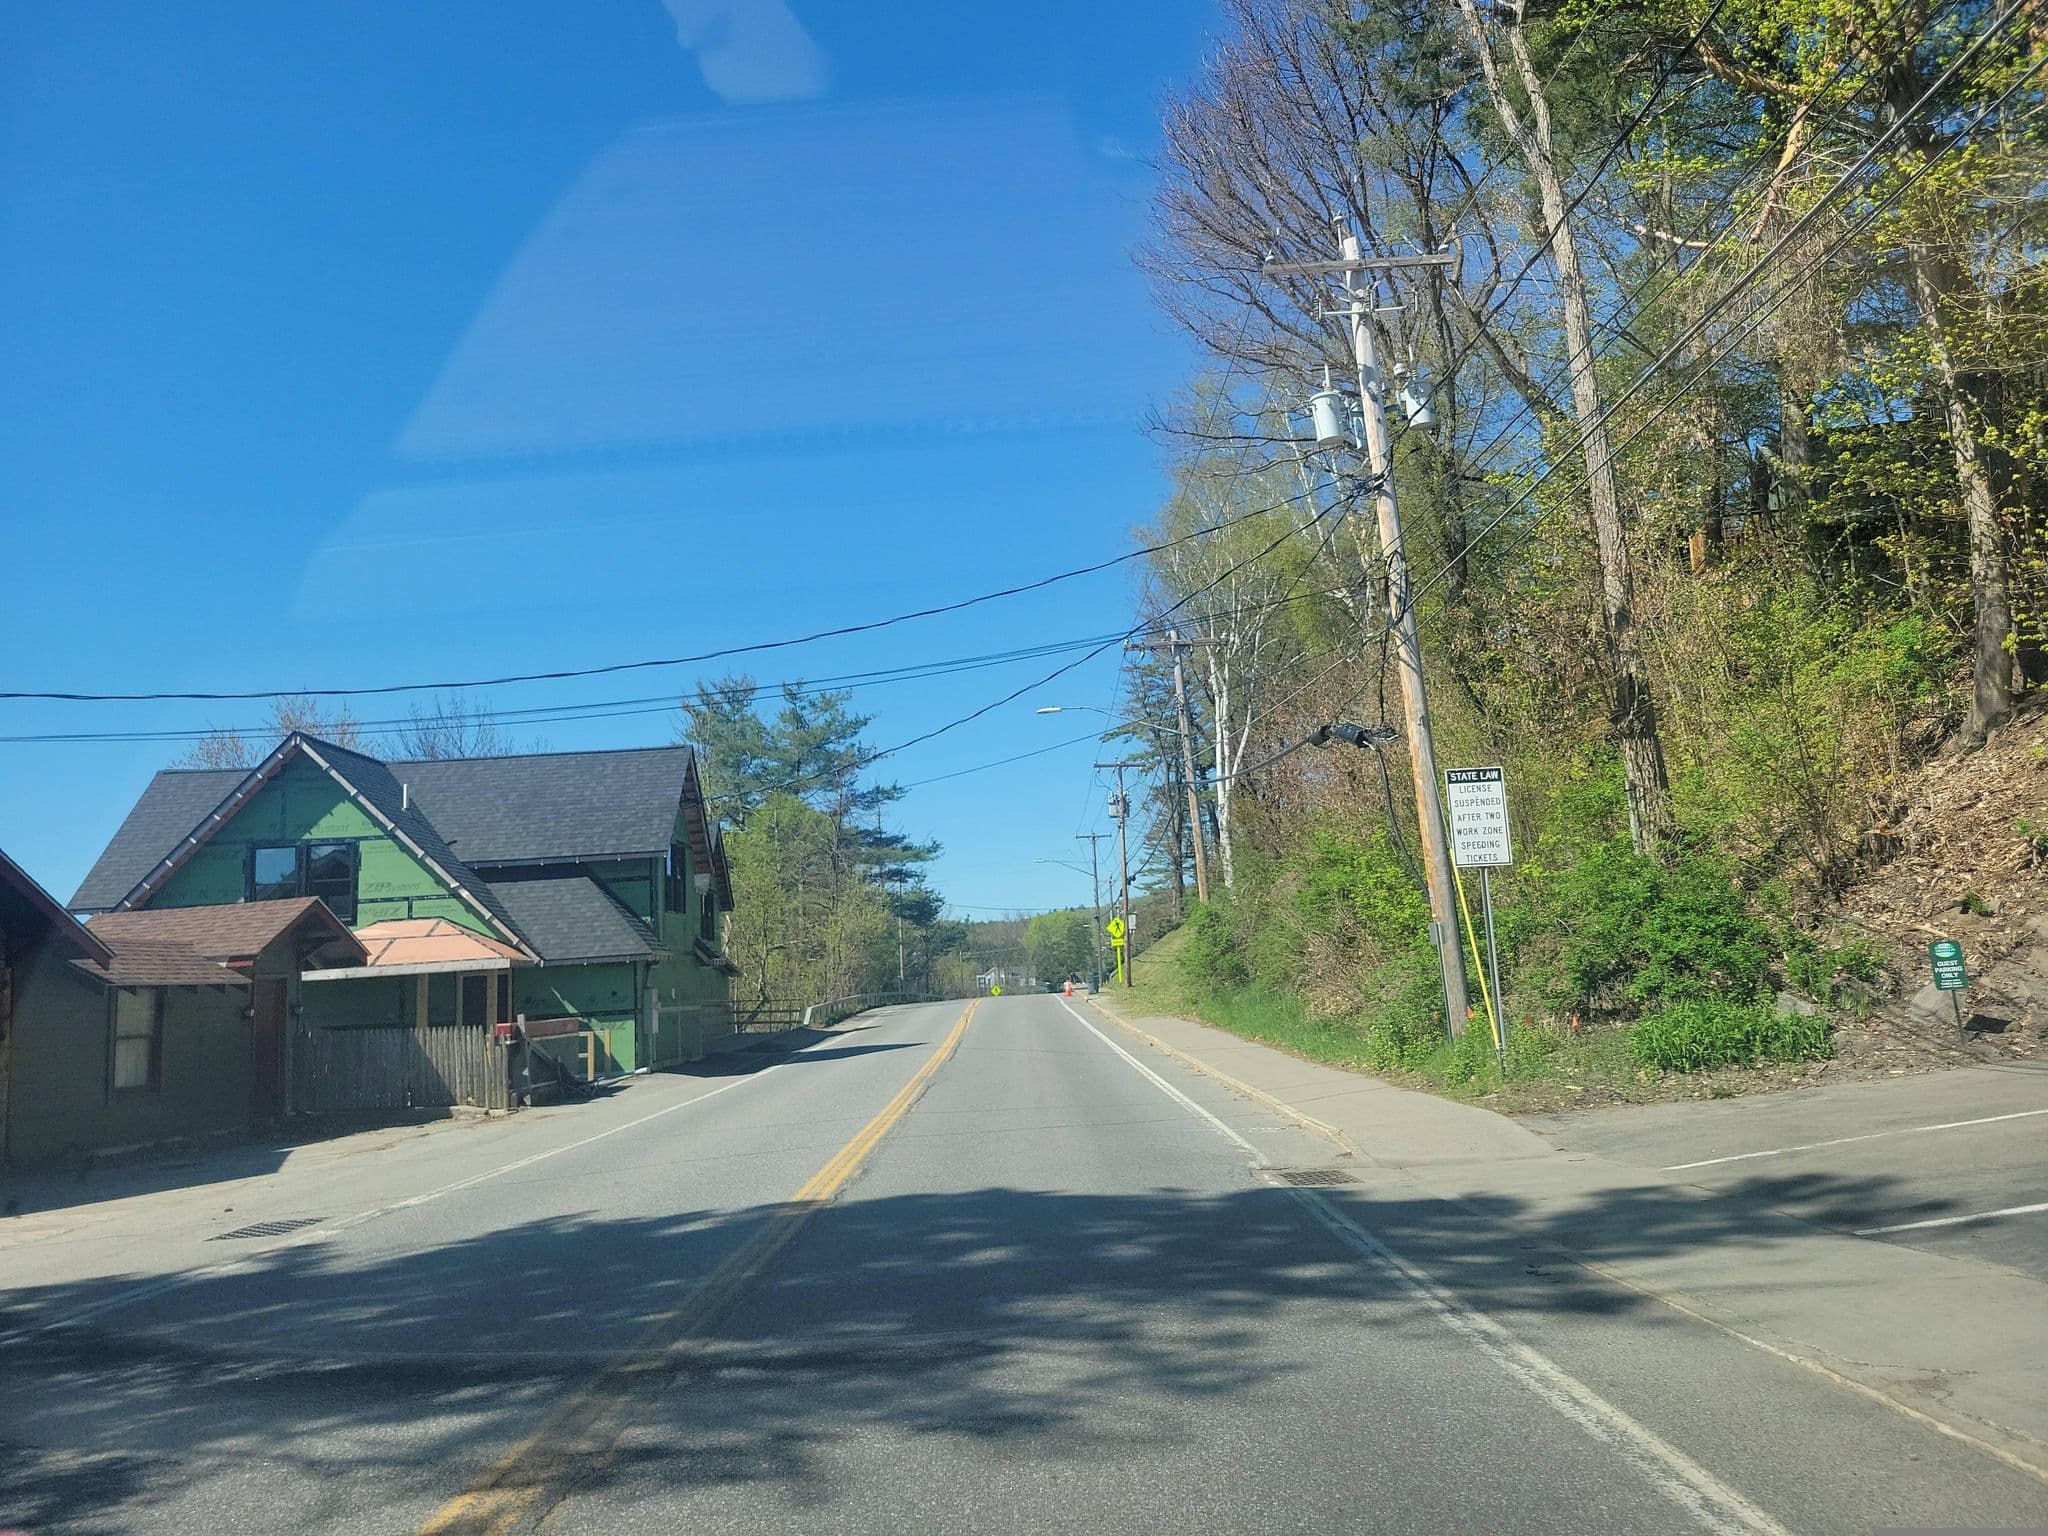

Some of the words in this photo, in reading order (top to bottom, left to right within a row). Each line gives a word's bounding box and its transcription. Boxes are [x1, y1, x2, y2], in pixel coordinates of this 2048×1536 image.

[1450, 772, 1478, 781] STATE
[1480, 771, 1498, 779] LAW
[1459, 784, 1492, 794] LICENSE
[1454, 798, 1501, 807] SUSPENDED
[1458, 813, 1481, 822] AFTER
[1483, 826, 1503, 834] ZONE
[1461, 840, 1500, 849] SPEEDING
[1466, 854, 1498, 862] TICKETS
